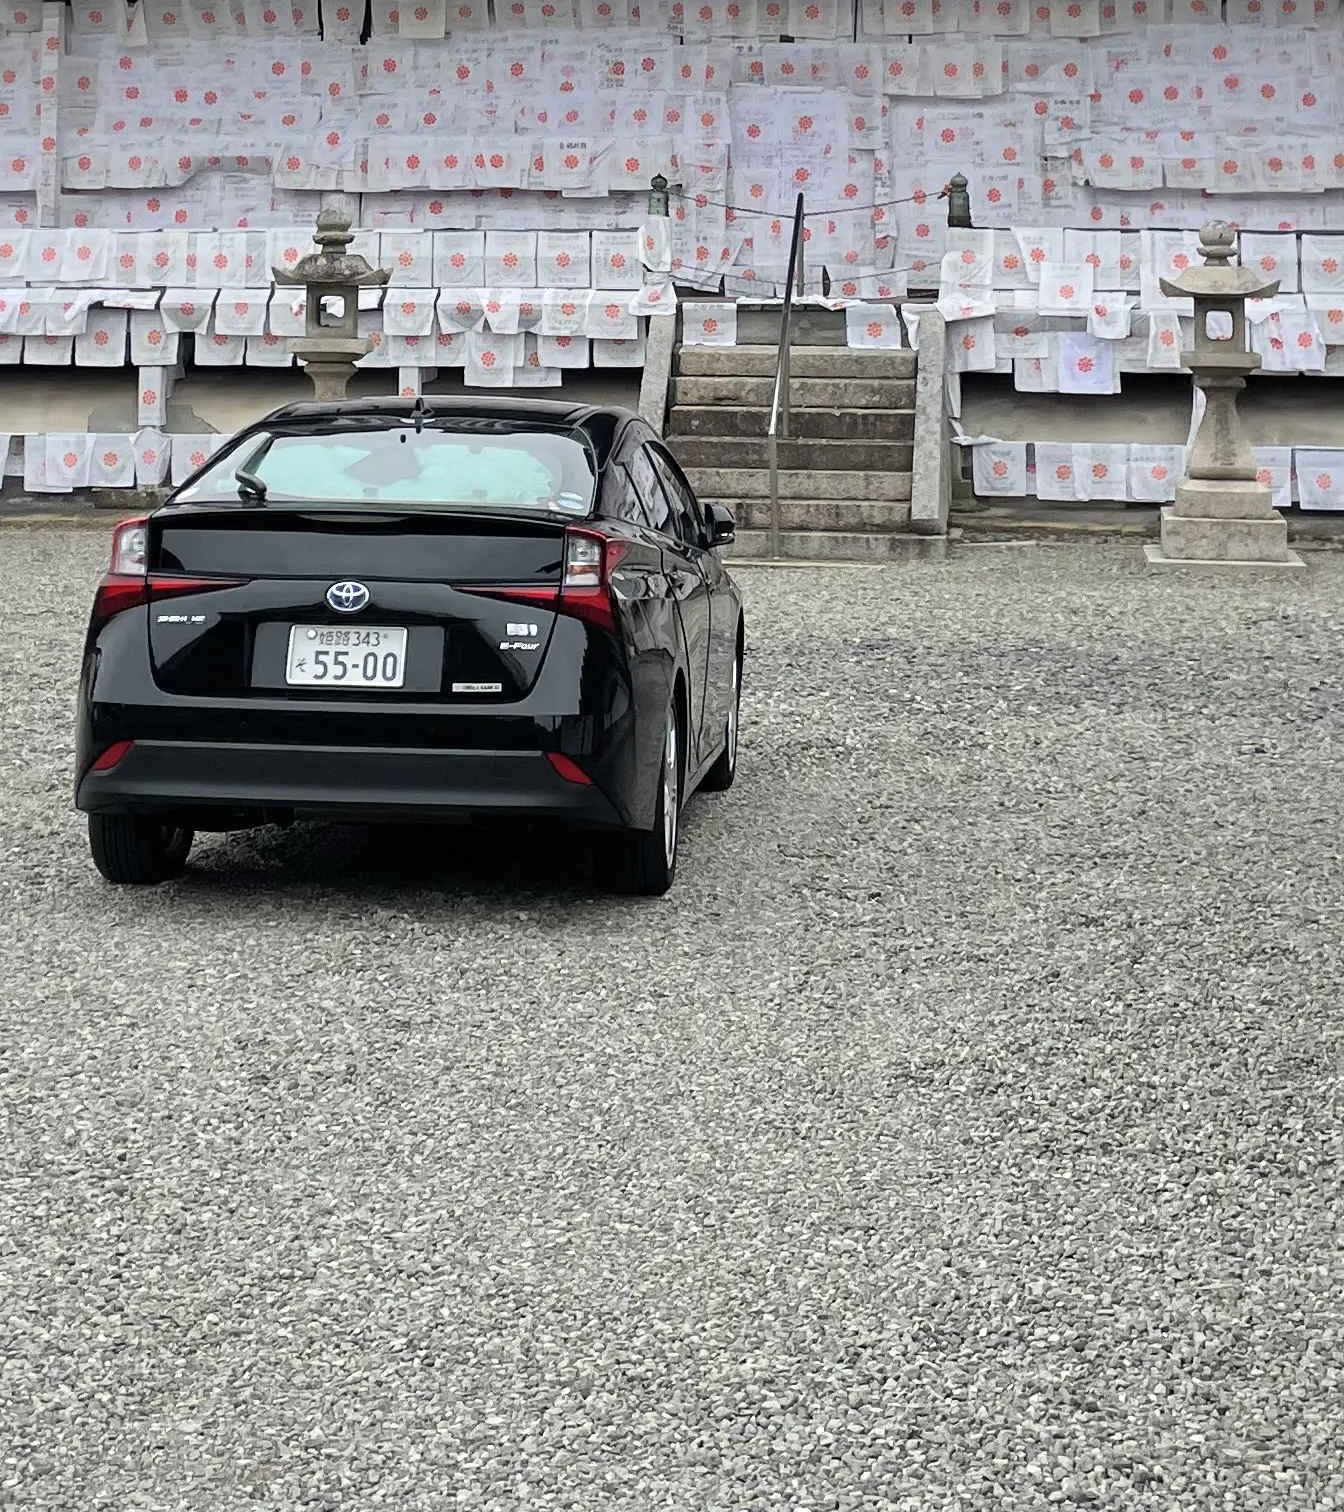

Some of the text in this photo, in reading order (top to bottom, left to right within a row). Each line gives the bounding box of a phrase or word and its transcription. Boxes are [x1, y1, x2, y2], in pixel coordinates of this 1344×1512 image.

[319, 630, 381, 647] 姫路 343
[313, 650, 398, 682] 55-00
